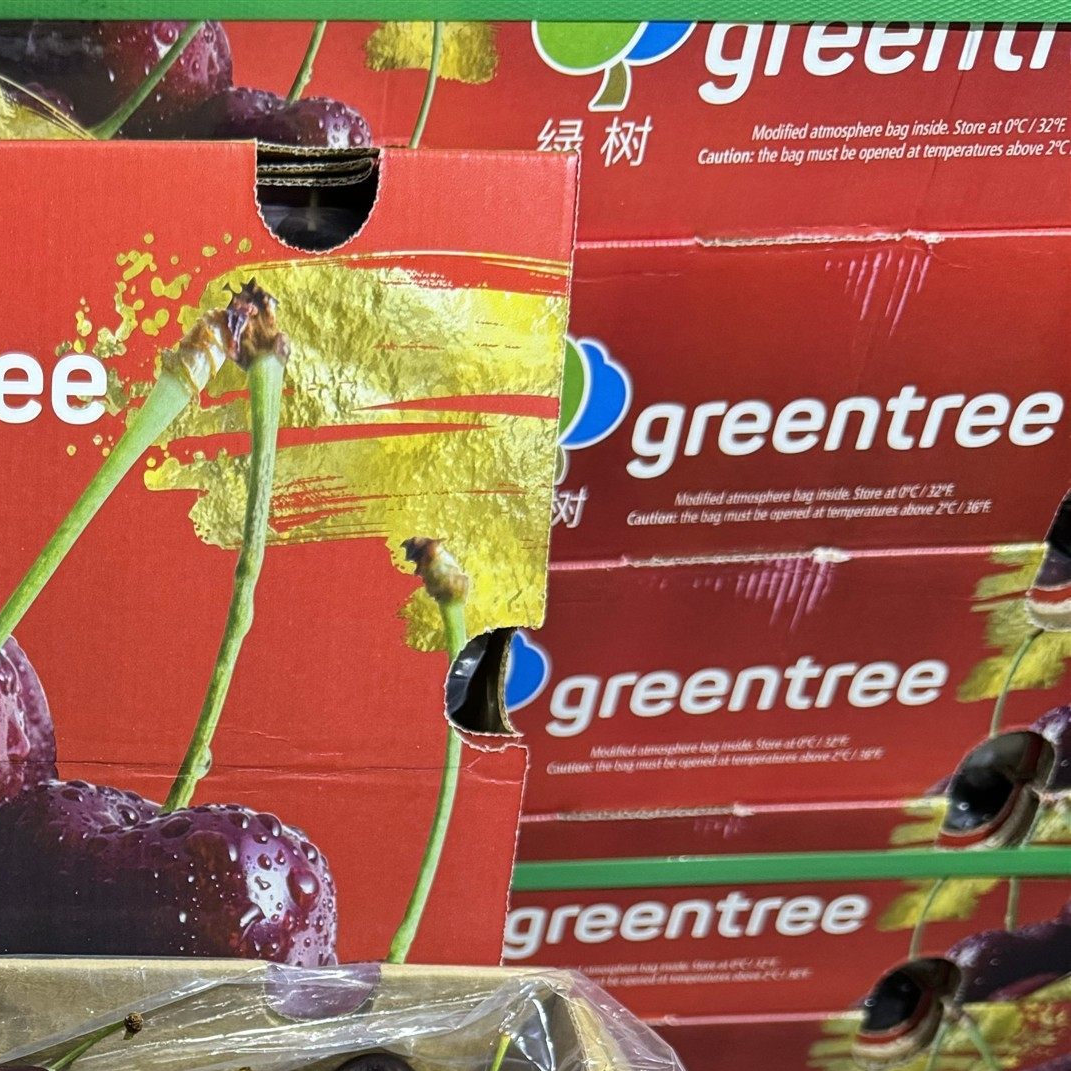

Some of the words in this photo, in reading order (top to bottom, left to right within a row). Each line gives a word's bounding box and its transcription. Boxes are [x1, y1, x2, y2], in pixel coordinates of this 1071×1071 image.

[697, 147, 754, 165] Caution:
[758, 146, 778, 163] the
[780, 146, 804, 166] bag
[807, 148, 837, 162] must
[840, 145, 859, 160] be
[859, 142, 906, 162] opened
[907, 145, 921, 158] at
[923, 142, 1003, 162] temperatures
[1005, 140, 1044, 156] above
[752, 123, 809, 141] Modified
[810, 121, 883, 142] atmosphere
[885, 121, 910, 140] bag
[912, 119, 949, 136] inside.
[953, 120, 987, 134] Store
[988, 121, 1002, 134] at
[627, 386, 1065, 479] greentree
[545, 655, 949, 738] greentree
[503, 892, 870, 960] greentree
